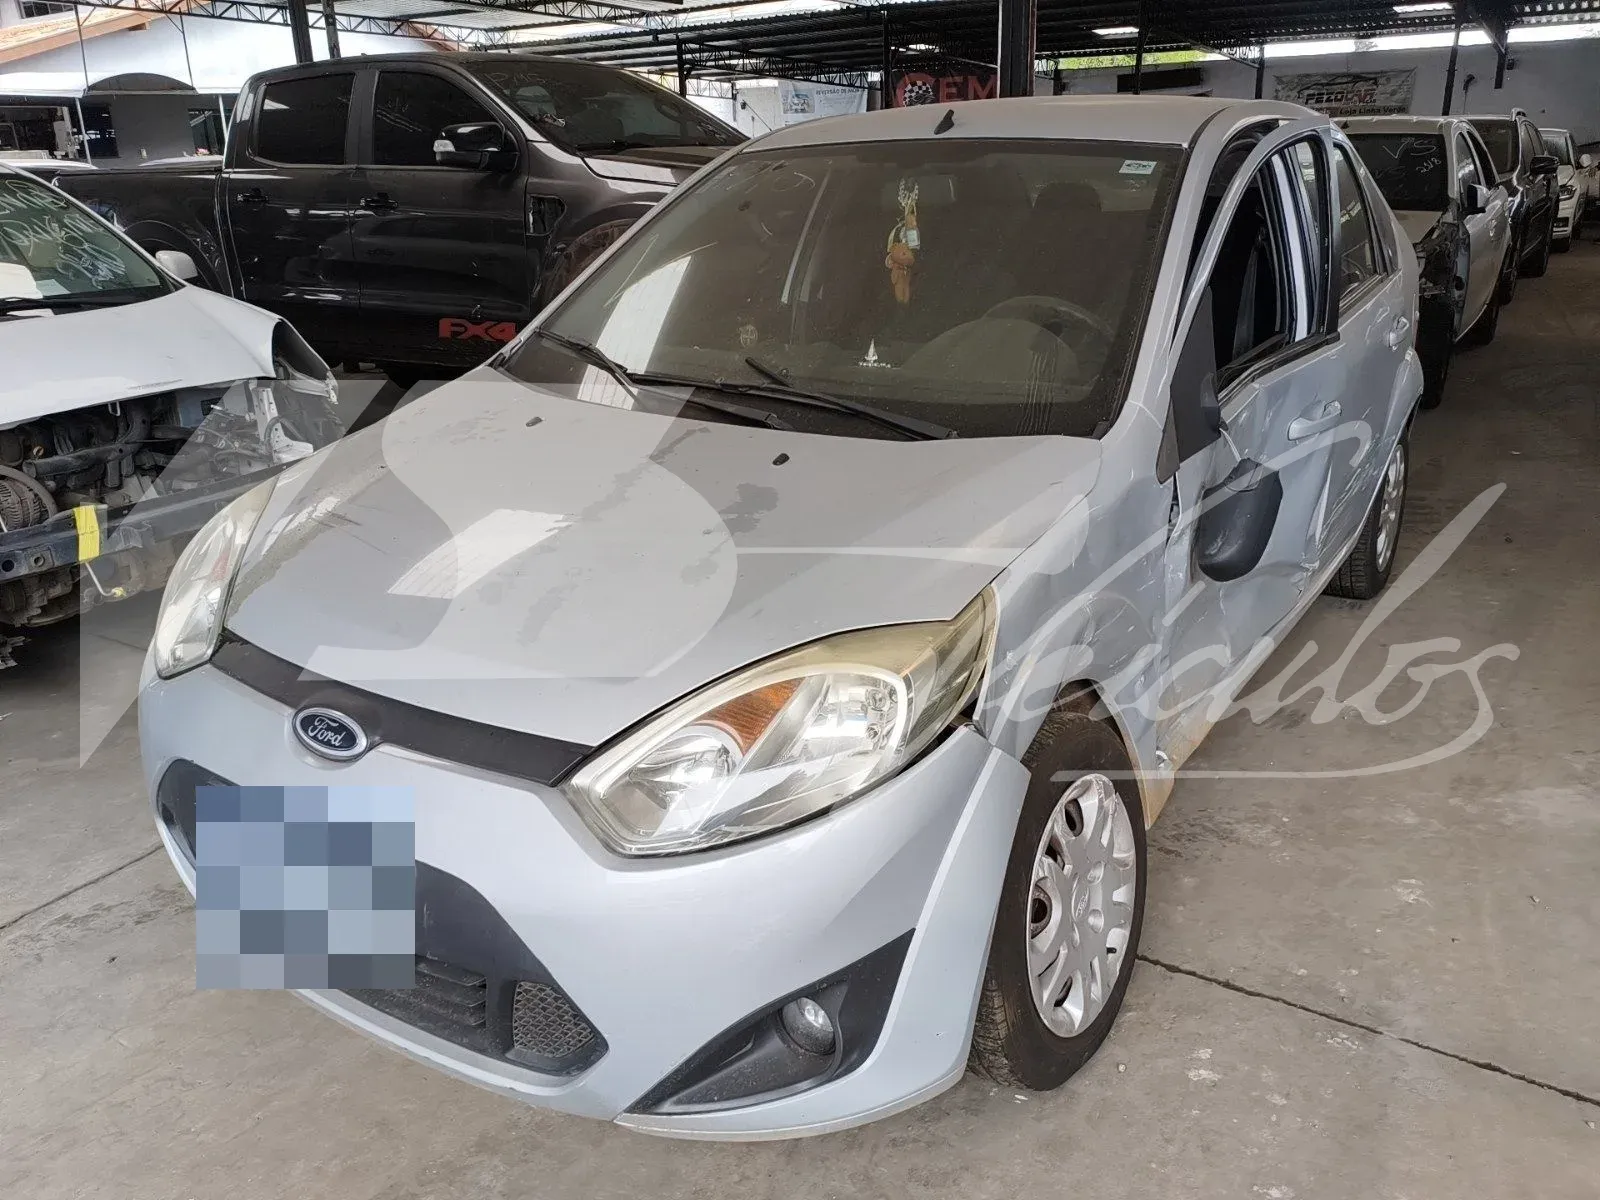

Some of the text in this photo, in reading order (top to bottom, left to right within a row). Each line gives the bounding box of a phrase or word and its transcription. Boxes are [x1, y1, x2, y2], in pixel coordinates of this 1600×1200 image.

[1340, 108, 1357, 116] Loja
[1359, 107, 1380, 115] Linha
[1383, 105, 1407, 114] Verde
[439, 318, 517, 342] FX4
[308, 716, 347, 747] Ford
